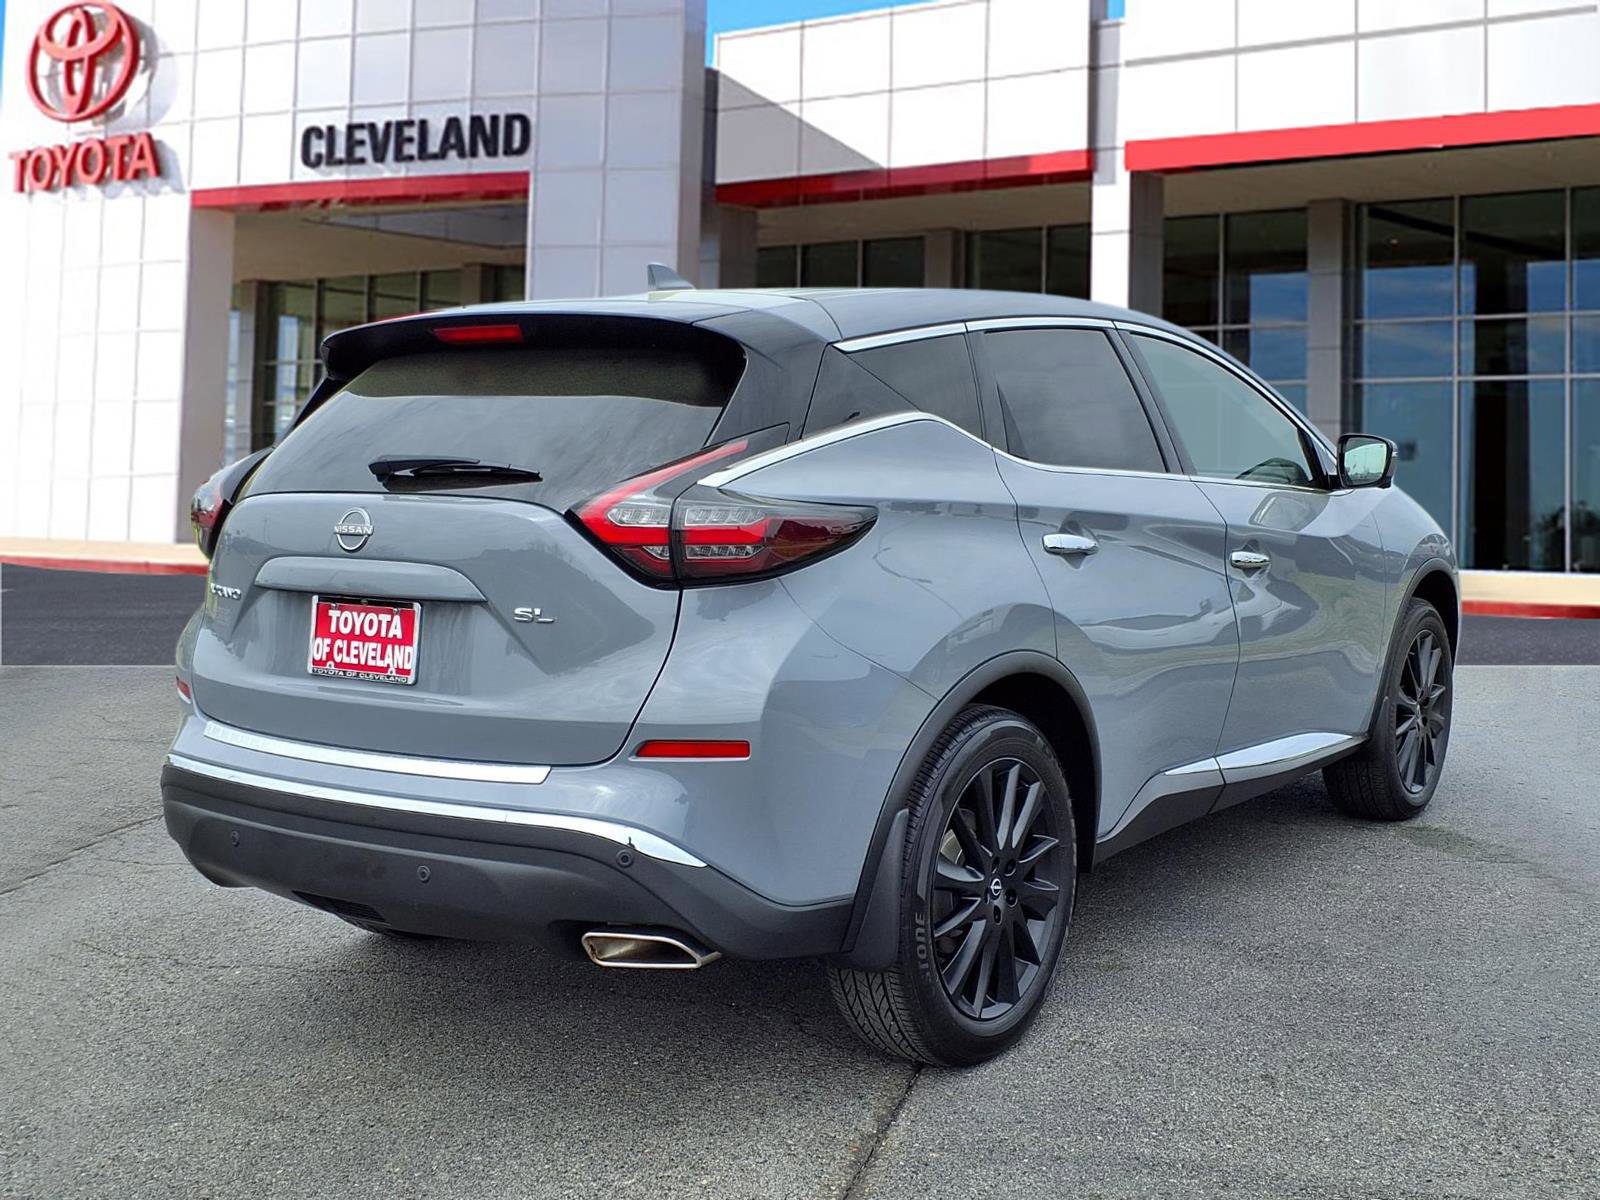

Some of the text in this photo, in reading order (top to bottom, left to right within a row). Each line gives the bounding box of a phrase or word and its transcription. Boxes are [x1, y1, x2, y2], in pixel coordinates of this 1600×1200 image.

[301, 113, 531, 169] CLEVELAND
[9, 132, 160, 194] TOYOTA
[334, 525, 373, 535] NISSAN
[328, 609, 403, 639] TOYOTA
[513, 607, 554, 622] SL
[313, 637, 413, 670] OF CLEVELAND
[313, 667, 344, 677] TOYOTA
[359, 673, 407, 683] CLEVELAND
